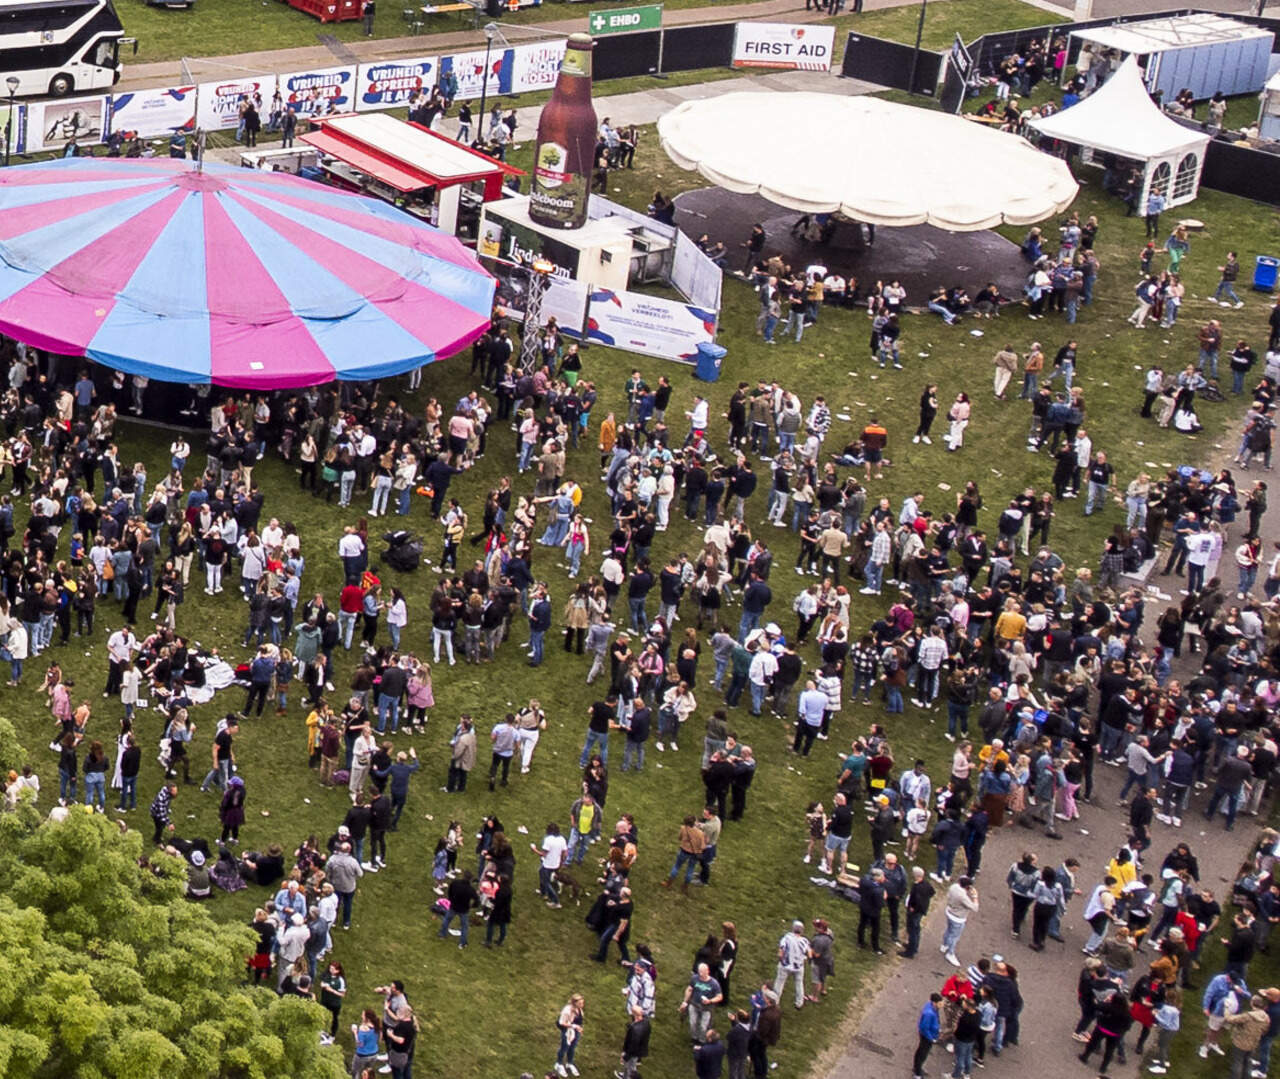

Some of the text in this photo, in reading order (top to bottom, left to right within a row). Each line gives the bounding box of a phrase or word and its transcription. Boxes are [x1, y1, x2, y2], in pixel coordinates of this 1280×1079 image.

[609, 13, 640, 27] EHBO
[745, 41, 827, 57] FIRST AID
[372, 64, 424, 81] VRIJHEID
[293, 74, 342, 91] VRIJHEID
[375, 77, 417, 93] SPREEK
